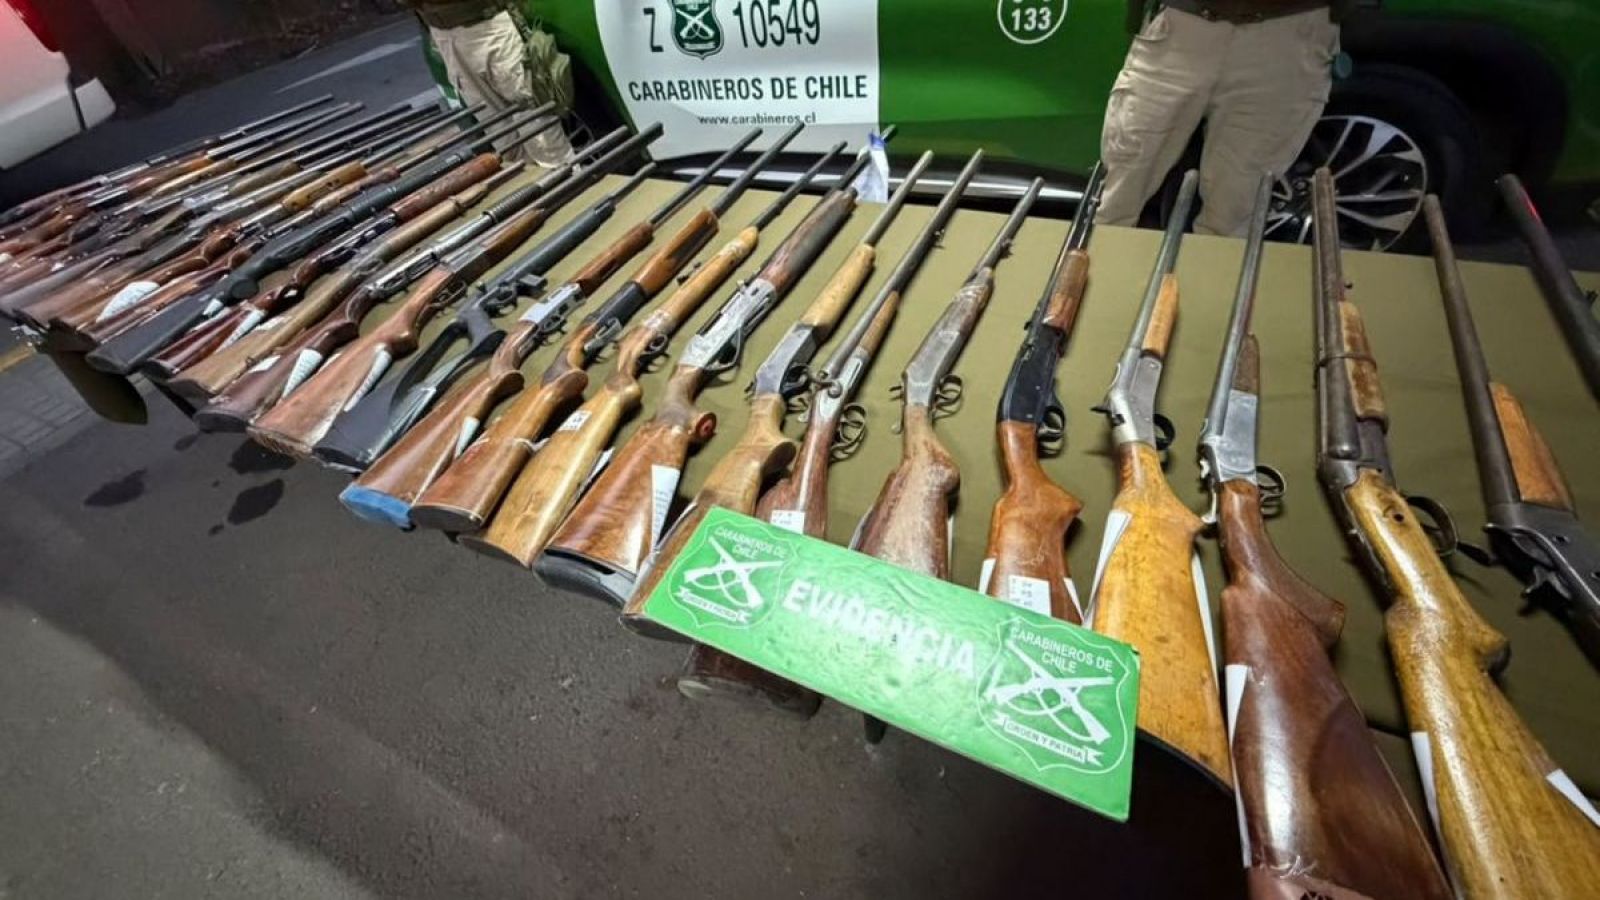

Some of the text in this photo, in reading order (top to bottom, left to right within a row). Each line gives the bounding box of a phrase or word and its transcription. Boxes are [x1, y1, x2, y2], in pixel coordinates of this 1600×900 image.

[643, 0, 820, 52] Z 10549
[1011, 7, 1052, 31] 133
[628, 75, 867, 101] CARABINEROS DE CHILE
[699, 112, 816, 126] www.carabineros.cl
[782, 578, 976, 679] EVIDENCIA
[1010, 625, 1114, 672] CARABINEROS DE
[1041, 651, 1078, 675] CHILE
